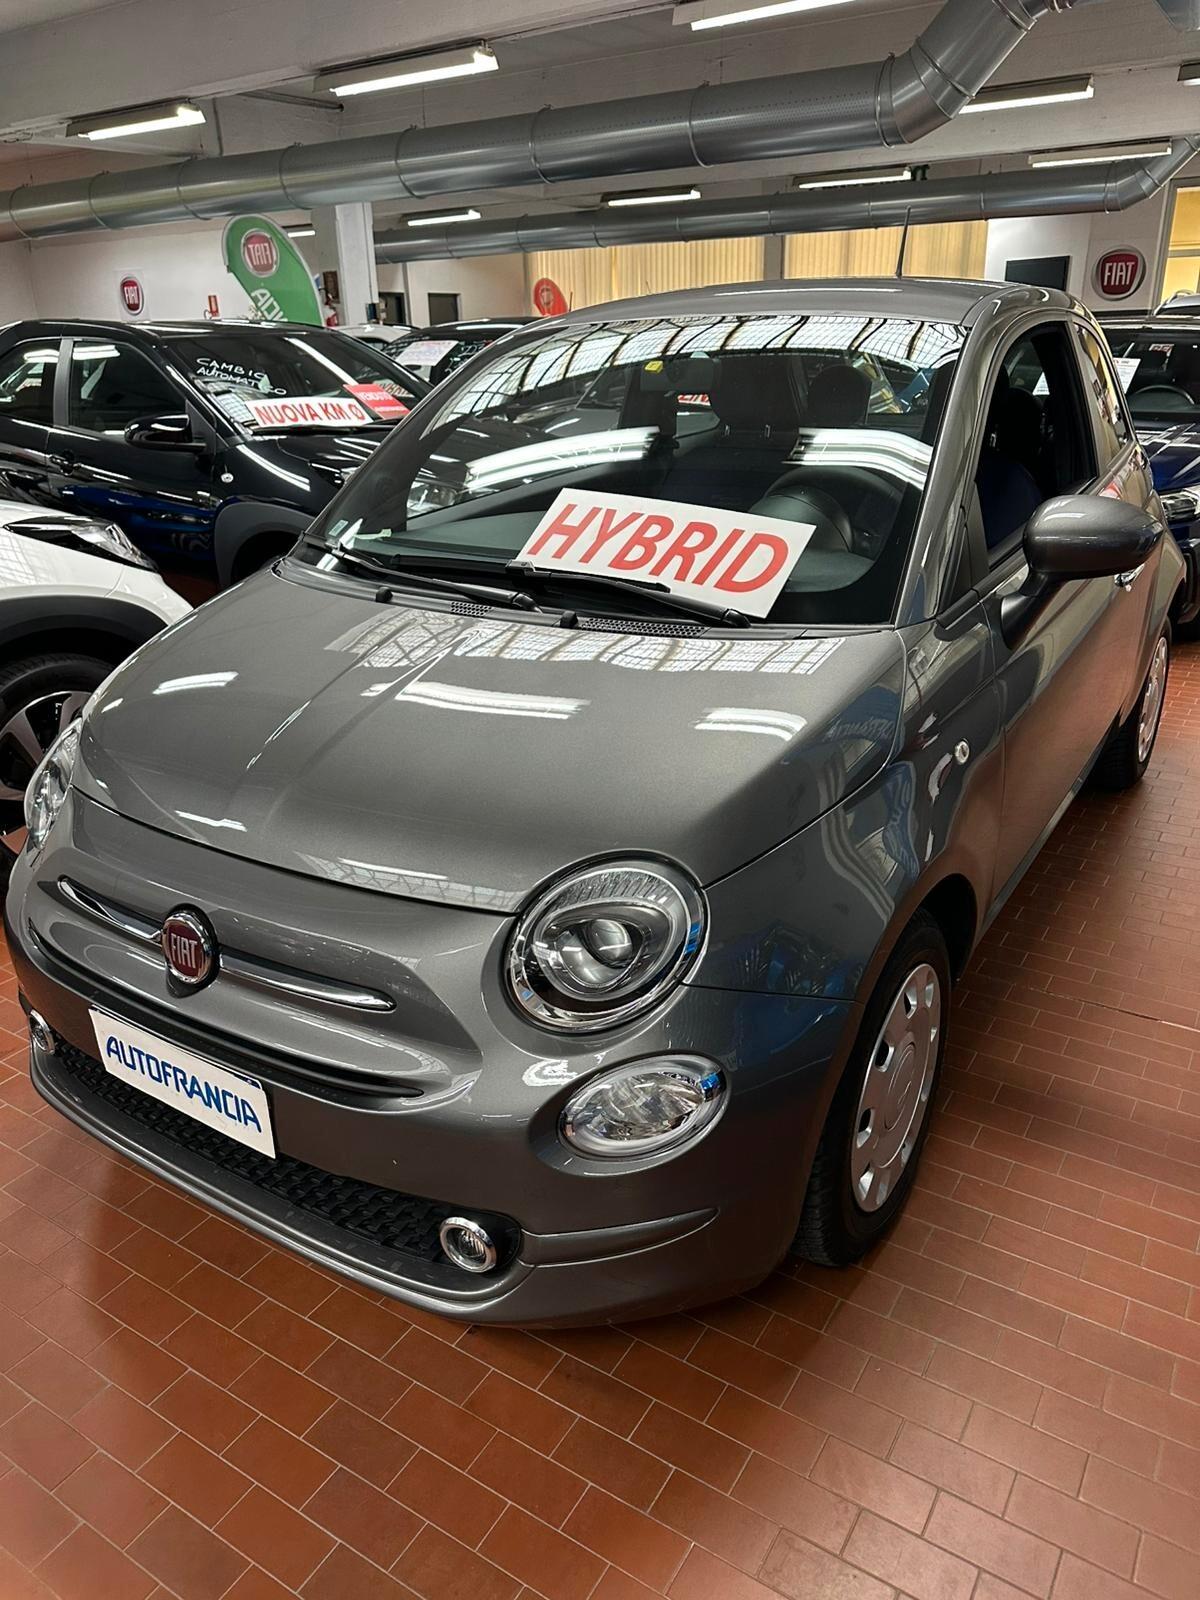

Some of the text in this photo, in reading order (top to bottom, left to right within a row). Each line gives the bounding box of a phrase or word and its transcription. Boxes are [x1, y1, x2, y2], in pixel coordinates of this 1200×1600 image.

[1103, 261, 1136, 287] FIAT
[123, 286, 139, 305] FIAT
[254, 402, 322, 425] NUOVA
[318, 403, 351, 421] KM
[527, 503, 789, 593] HYBRID
[170, 932, 198, 969] FIAT
[105, 1035, 263, 1133] AUTOFRANCIA
